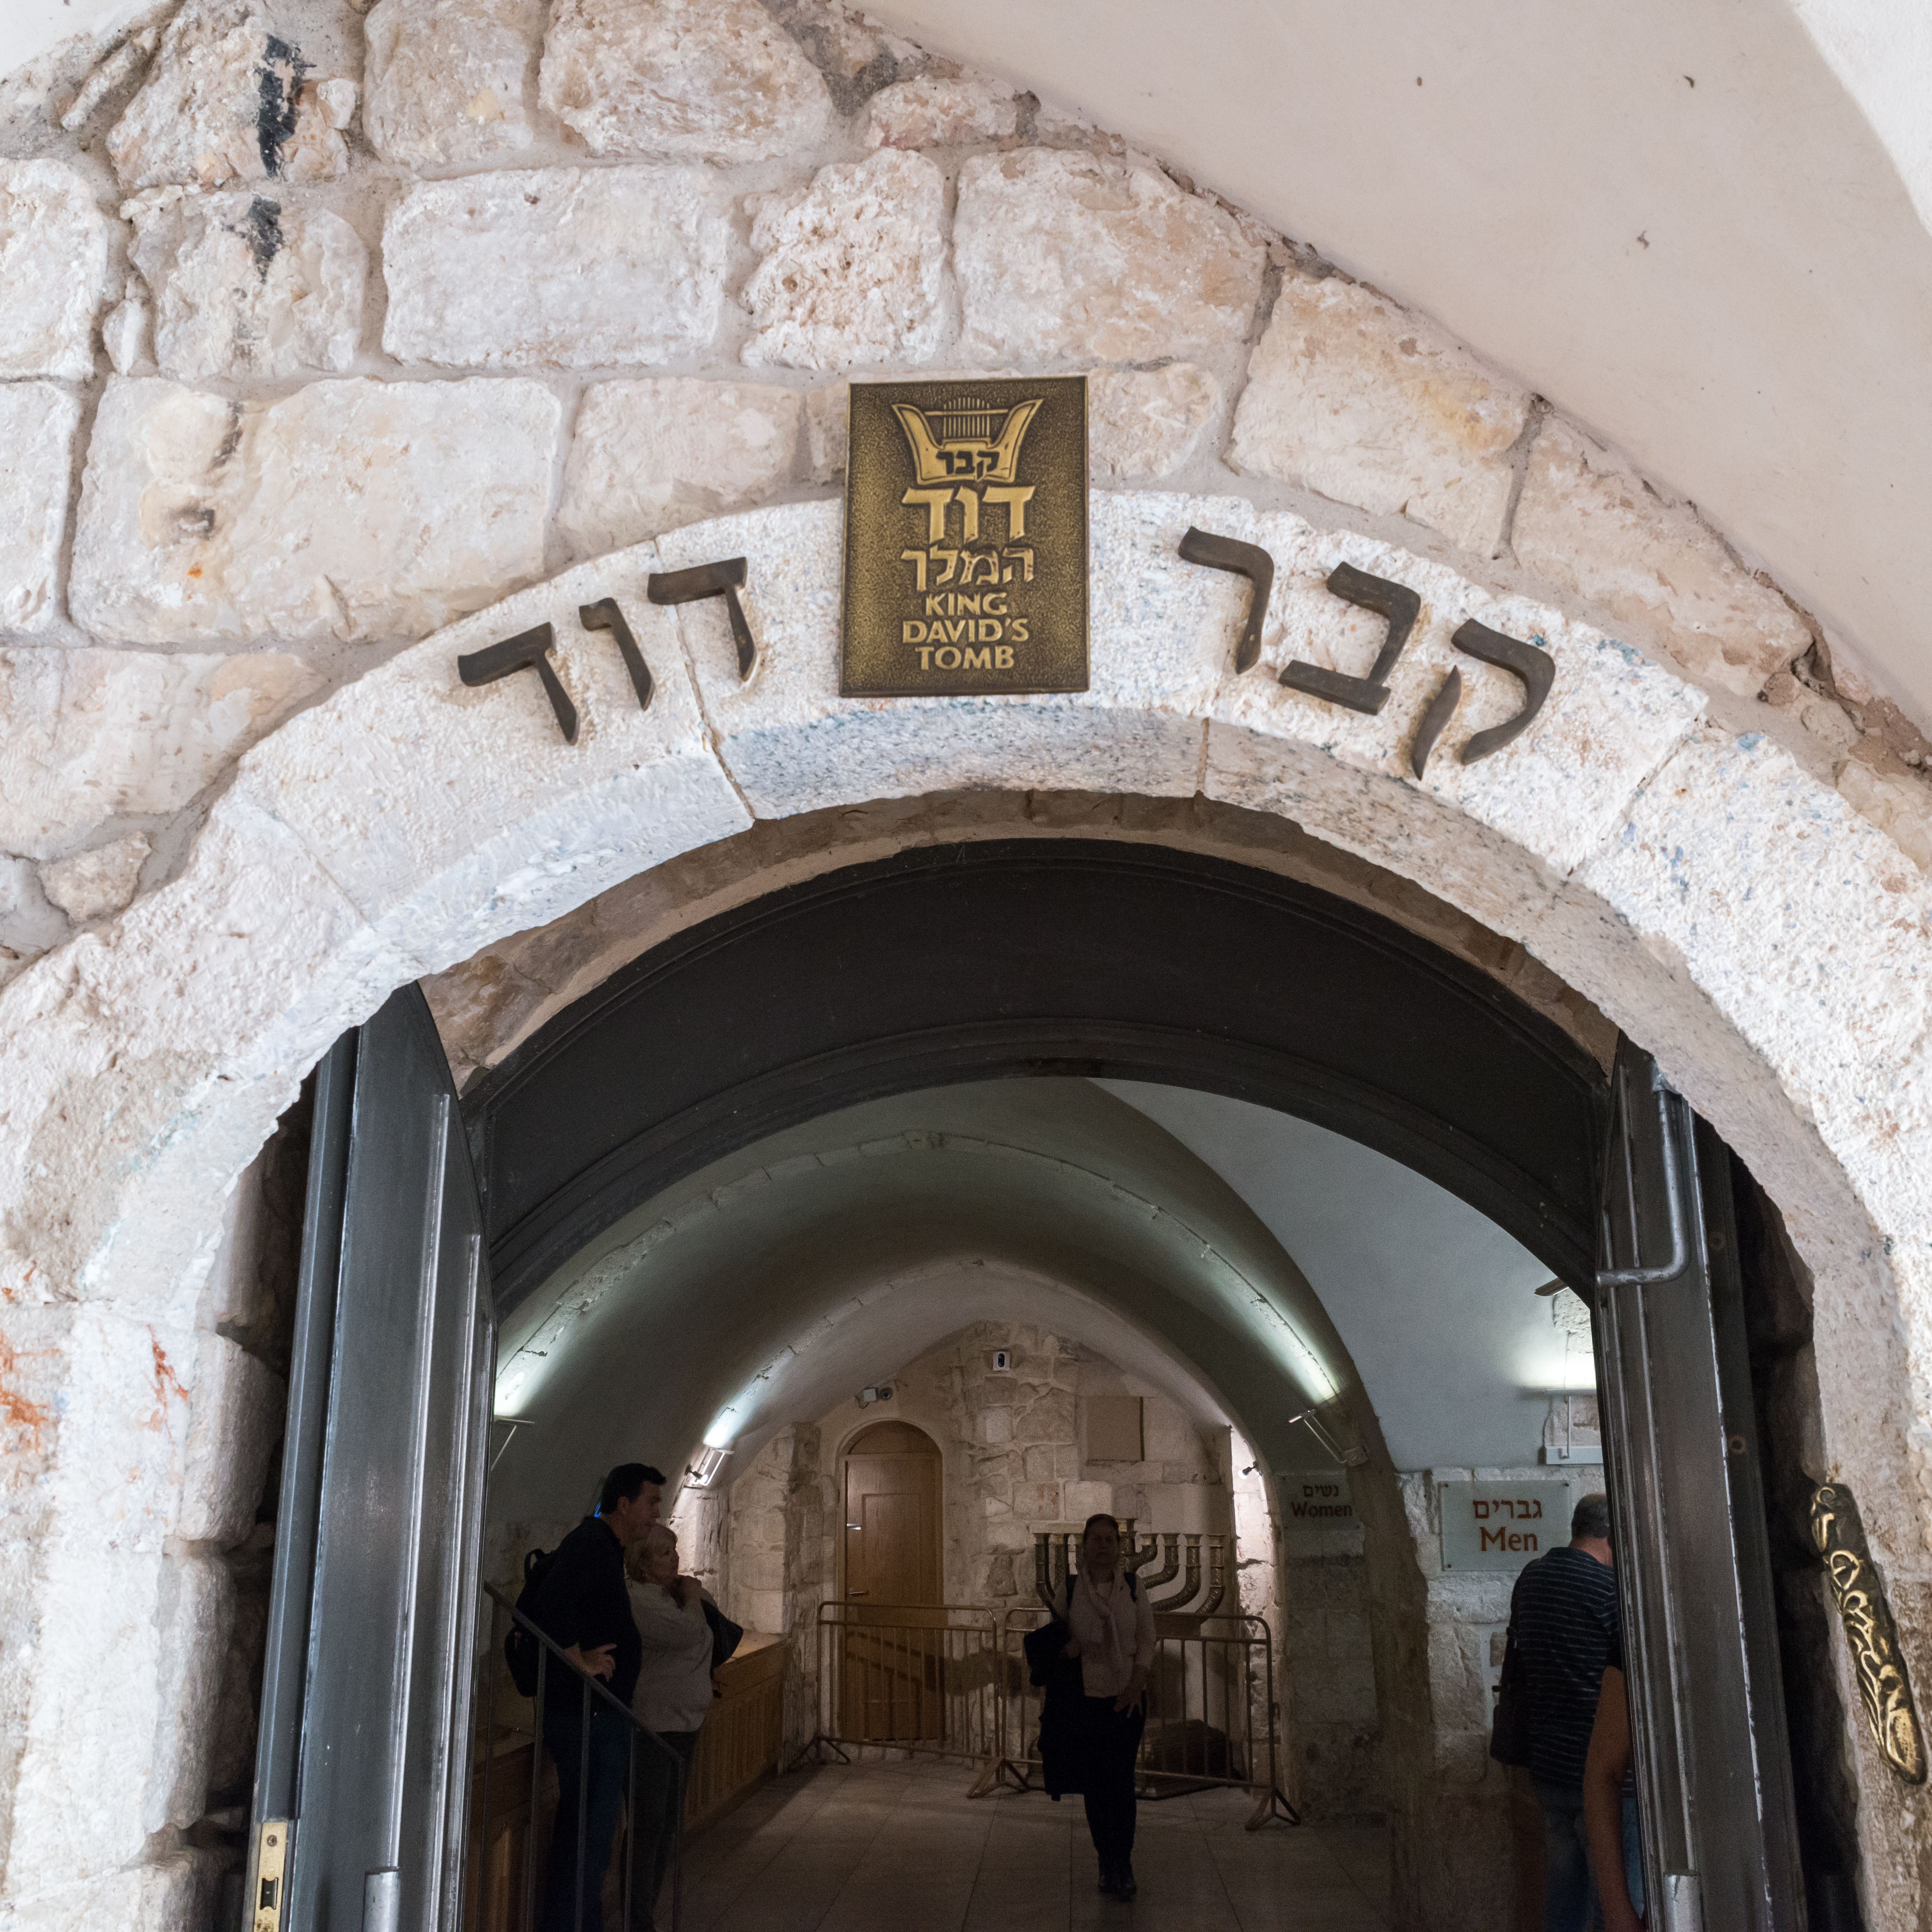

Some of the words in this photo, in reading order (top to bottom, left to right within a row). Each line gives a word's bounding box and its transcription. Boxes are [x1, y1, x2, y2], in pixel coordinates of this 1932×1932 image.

[936, 450, 1001, 483] קבר
[902, 485, 1036, 544] דוד
[901, 545, 1034, 592] המלך
[925, 592, 1008, 616] KING
[902, 618, 1029, 643] DAVID'S
[457, 557, 758, 746] דוד
[914, 645, 1015, 671] TOMB
[1178, 525, 1556, 781] קבר
[1303, 1484, 1339, 1497] נשים
[1291, 1501, 1353, 1517] Women
[1473, 1499, 1543, 1519] גברים
[1479, 1526, 1538, 1552] Men
